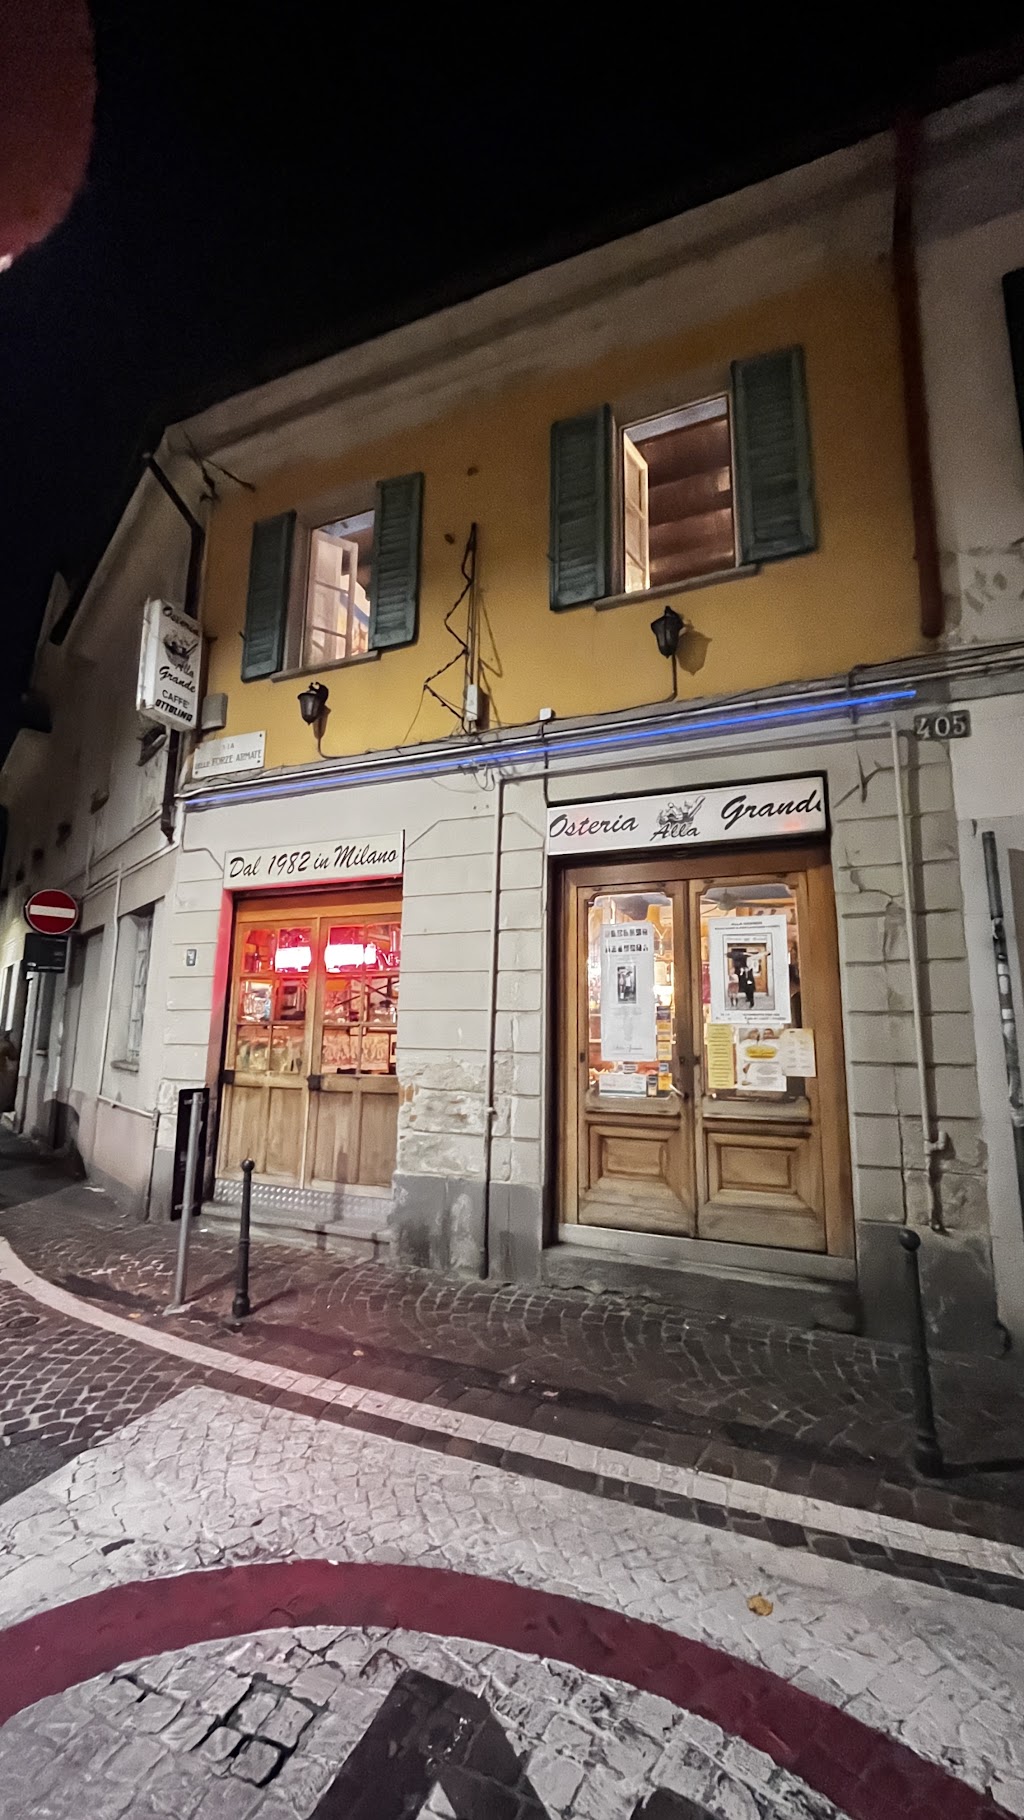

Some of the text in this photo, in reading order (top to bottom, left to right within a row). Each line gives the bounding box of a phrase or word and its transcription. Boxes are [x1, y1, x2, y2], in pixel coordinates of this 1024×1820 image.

[159, 666, 196, 693] Grande
[916, 715, 966, 738] 405
[211, 755, 233, 766] FORZE
[236, 749, 262, 761] ARMATE
[550, 813, 639, 838] Osteria
[650, 823, 701, 841] Alla
[229, 844, 399, 878] Dal 1982 in Milano
